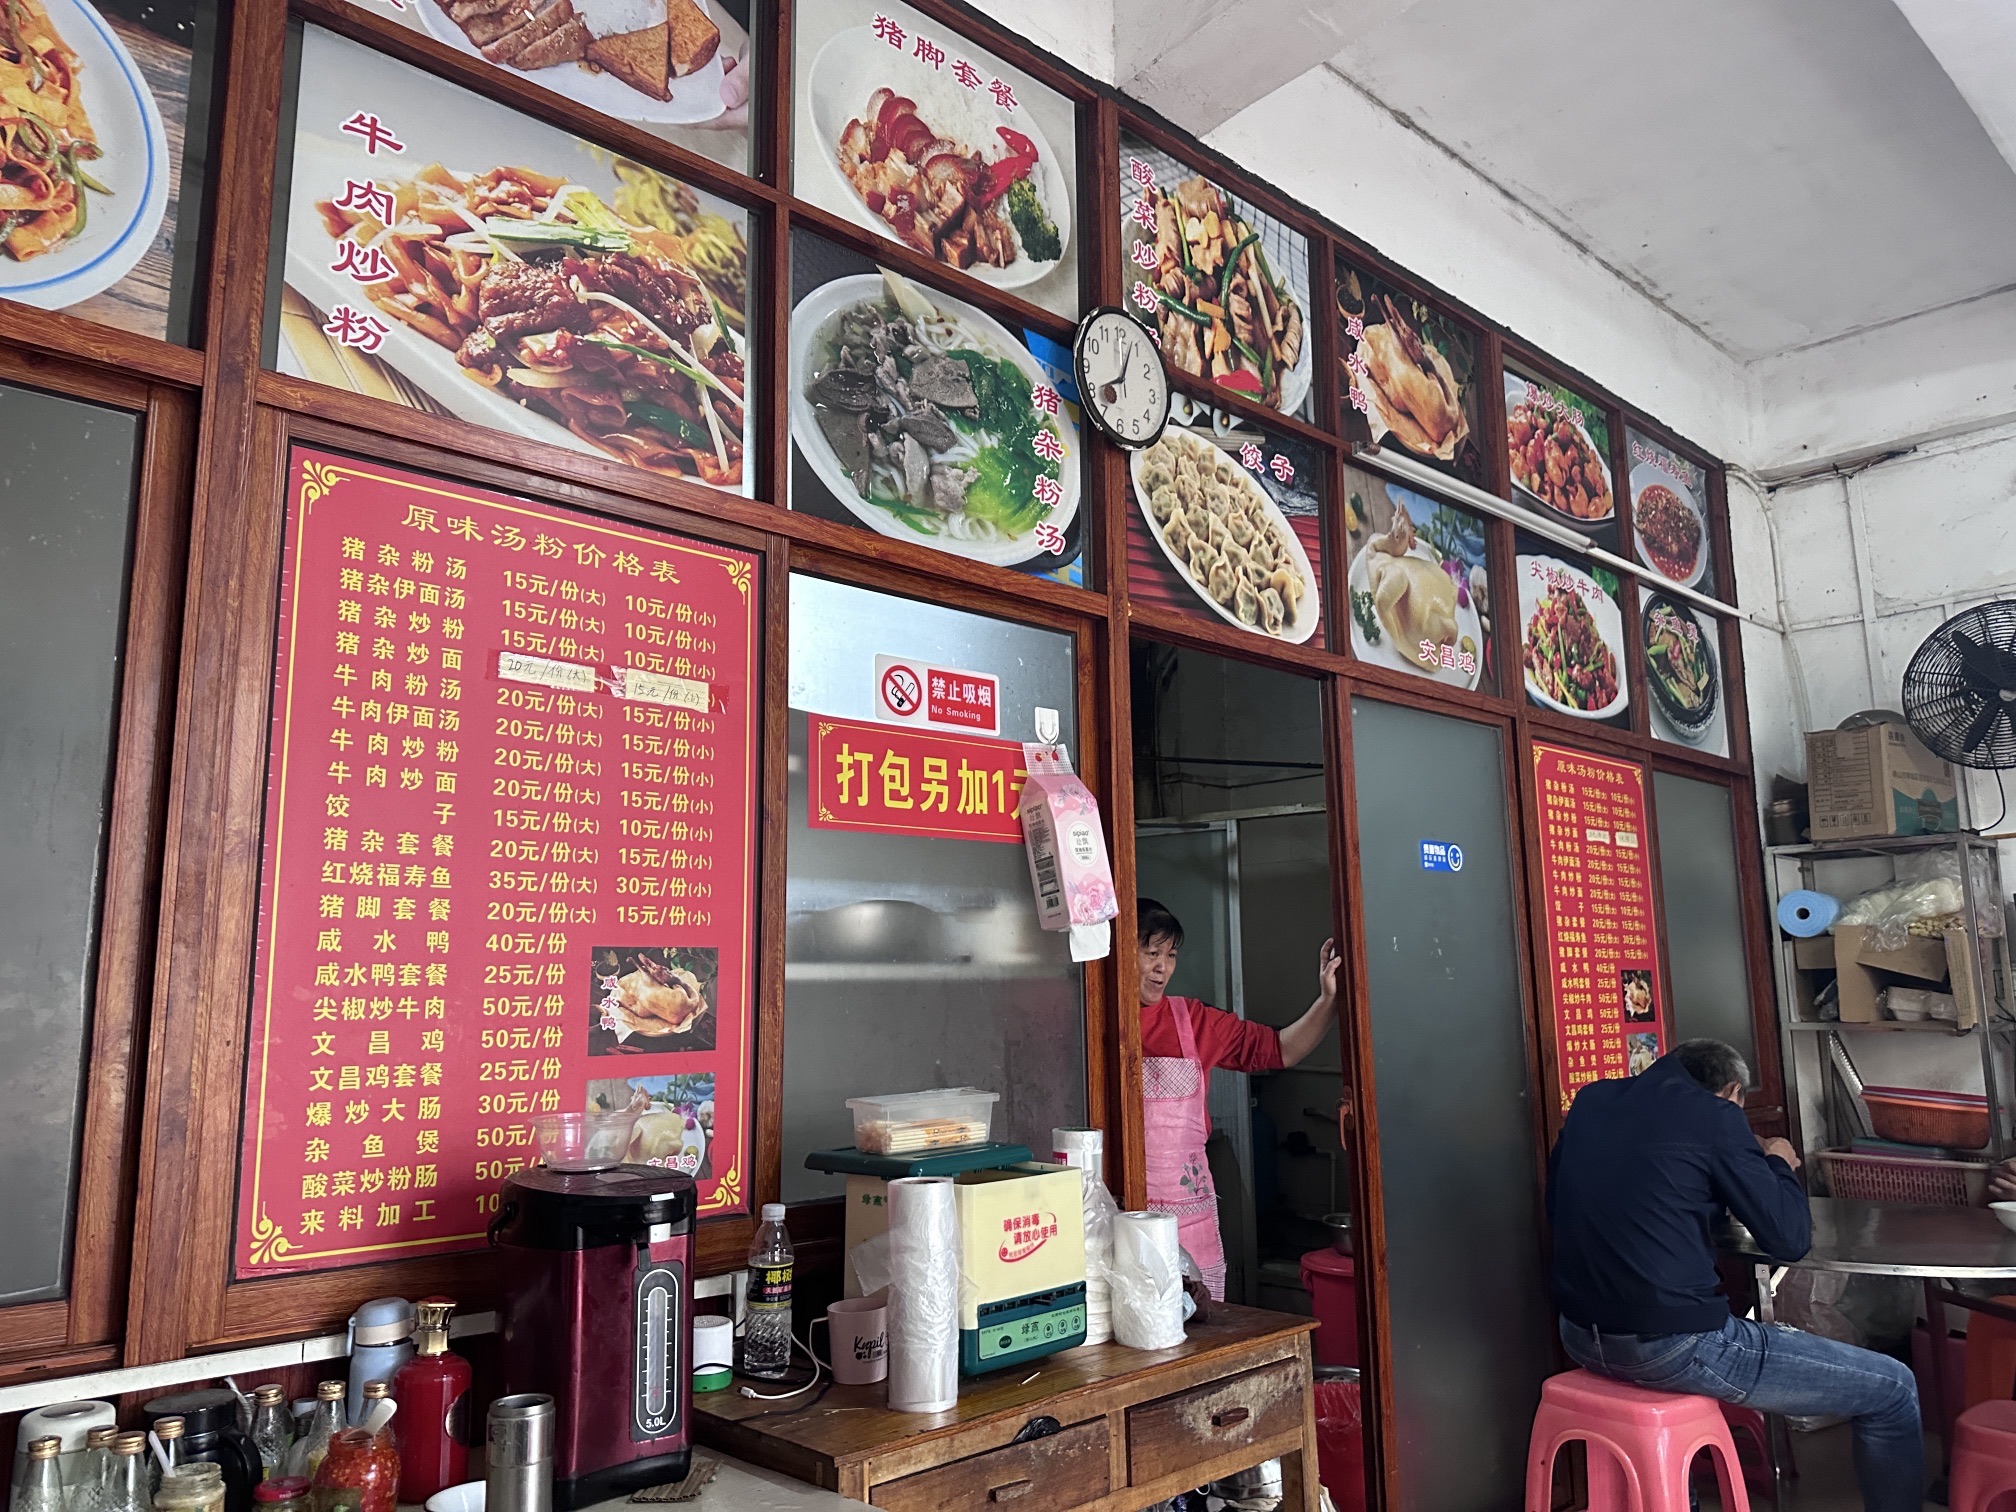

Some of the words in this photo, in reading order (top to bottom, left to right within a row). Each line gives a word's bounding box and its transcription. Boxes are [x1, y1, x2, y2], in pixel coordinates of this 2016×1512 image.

[872, 14, 1018, 112] 猪脚套餐
[325, 111, 405, 353] 牛肉炒粉
[1129, 157, 1162, 349] 酸菜炒粉
[1087, 336, 1099, 354] 10
[1100, 325, 1109, 343] 11
[1114, 326, 1126, 344] 12
[1135, 343, 1139, 357] 1
[1083, 358, 1090, 373] 9
[1144, 364, 1150, 380] 2
[1346, 317, 1368, 414] 咸水鸭
[1089, 382, 1095, 398] 8
[1149, 389, 1156, 404] 3
[1101, 404, 1108, 418] 7
[1116, 418, 1124, 434] 6
[1133, 419, 1140, 434] 5
[1143, 409, 1150, 423] 4
[1031, 382, 1066, 556] 猪杂粉汤
[1240, 442, 1295, 483] 饺子
[401, 504, 680, 584] 原味汤粉价格表
[342, 537, 466, 580] 猪杂粉汤
[504, 570, 606, 606] 15元/份(大)
[626, 595, 716, 626] 10元/份(小)
[1530, 560, 1604, 603] 尖椒炒牛肉
[339, 568, 465, 610] 猪杂伊面汤
[502, 600, 605, 633] 15元/份(大)
[625, 623, 716, 652] 10元/份(小)
[336, 631, 462, 671] 猪杂炒面
[338, 600, 464, 640] 猪杂炒粉
[501, 629, 604, 662] 15元/份(大)
[624, 651, 715, 679] 10元/份(小)
[507, 658, 587, 683] 20元/份(大)
[1419, 639, 1476, 675] 文昌鸡
[334, 664, 461, 701] 牛肉粉汤
[497, 688, 603, 718] 20元/份(大)
[624, 706, 714, 732] 15元/份(小)
[932, 677, 991, 707] 禁止吸烟
[332, 696, 460, 731] 牛肉伊面汤
[496, 718, 602, 747] 20元/份(大)
[622, 734, 714, 760] 15元/份(小)
[931, 705, 942, 714] No
[947, 707, 980, 721] Smoking
[329, 728, 459, 762] 牛肉炒粉
[495, 748, 601, 776] 20元/份(大)
[621, 762, 713, 787] 15元/份(小)
[328, 761, 456, 794] 牛肉炒面
[493, 778, 600, 805] 20元/份(大)
[620, 791, 713, 814] 15元/份(小)
[325, 794, 456, 825] 饺子
[494, 809, 600, 834] 15元/份(大)
[620, 819, 712, 842] 10元/份(小)
[323, 827, 454, 857] 猪杂套餐
[490, 840, 598, 863] 20元/份(大)
[619, 848, 712, 869] 15元/份(小)
[321, 860, 451, 889] 红烧福寿鱼
[489, 871, 597, 893] 35元/份(大)
[616, 877, 711, 897] 30元/份(小)
[320, 894, 450, 921] 猪脚套餐
[487, 902, 596, 923] 20元/份(大)
[617, 906, 711, 925] 15元/份(小)
[316, 928, 449, 954] 咸水鸭
[486, 932, 567, 954] 40元/份
[314, 962, 447, 987] 咸水鸭套餐
[484, 963, 566, 985] 25元/份
[314, 996, 445, 1021] 尖椒炒牛肉
[483, 994, 565, 1017] 50元/份
[600, 976, 618, 1030] 咸水鸭
[311, 1029, 445, 1056] 文昌鸡
[481, 1026, 563, 1049] 50元/份
[309, 1062, 443, 1091] 文昌鸡套餐
[479, 1057, 562, 1081] 25元/份
[306, 1096, 441, 1127] 爆炒大肠
[478, 1089, 560, 1114] 30元/份
[304, 1130, 439, 1163] 杂鱼煲
[302, 1164, 437, 1200] 酸菜炒粉肠
[475, 1157, 545, 1182] 50元/
[300, 1200, 435, 1235] 来料加工
[1003, 1213, 1040, 1232] 确保消毒
[1013, 1224, 1058, 1245] 请放心使用
[646, 1417, 666, 1428] 5.0L
